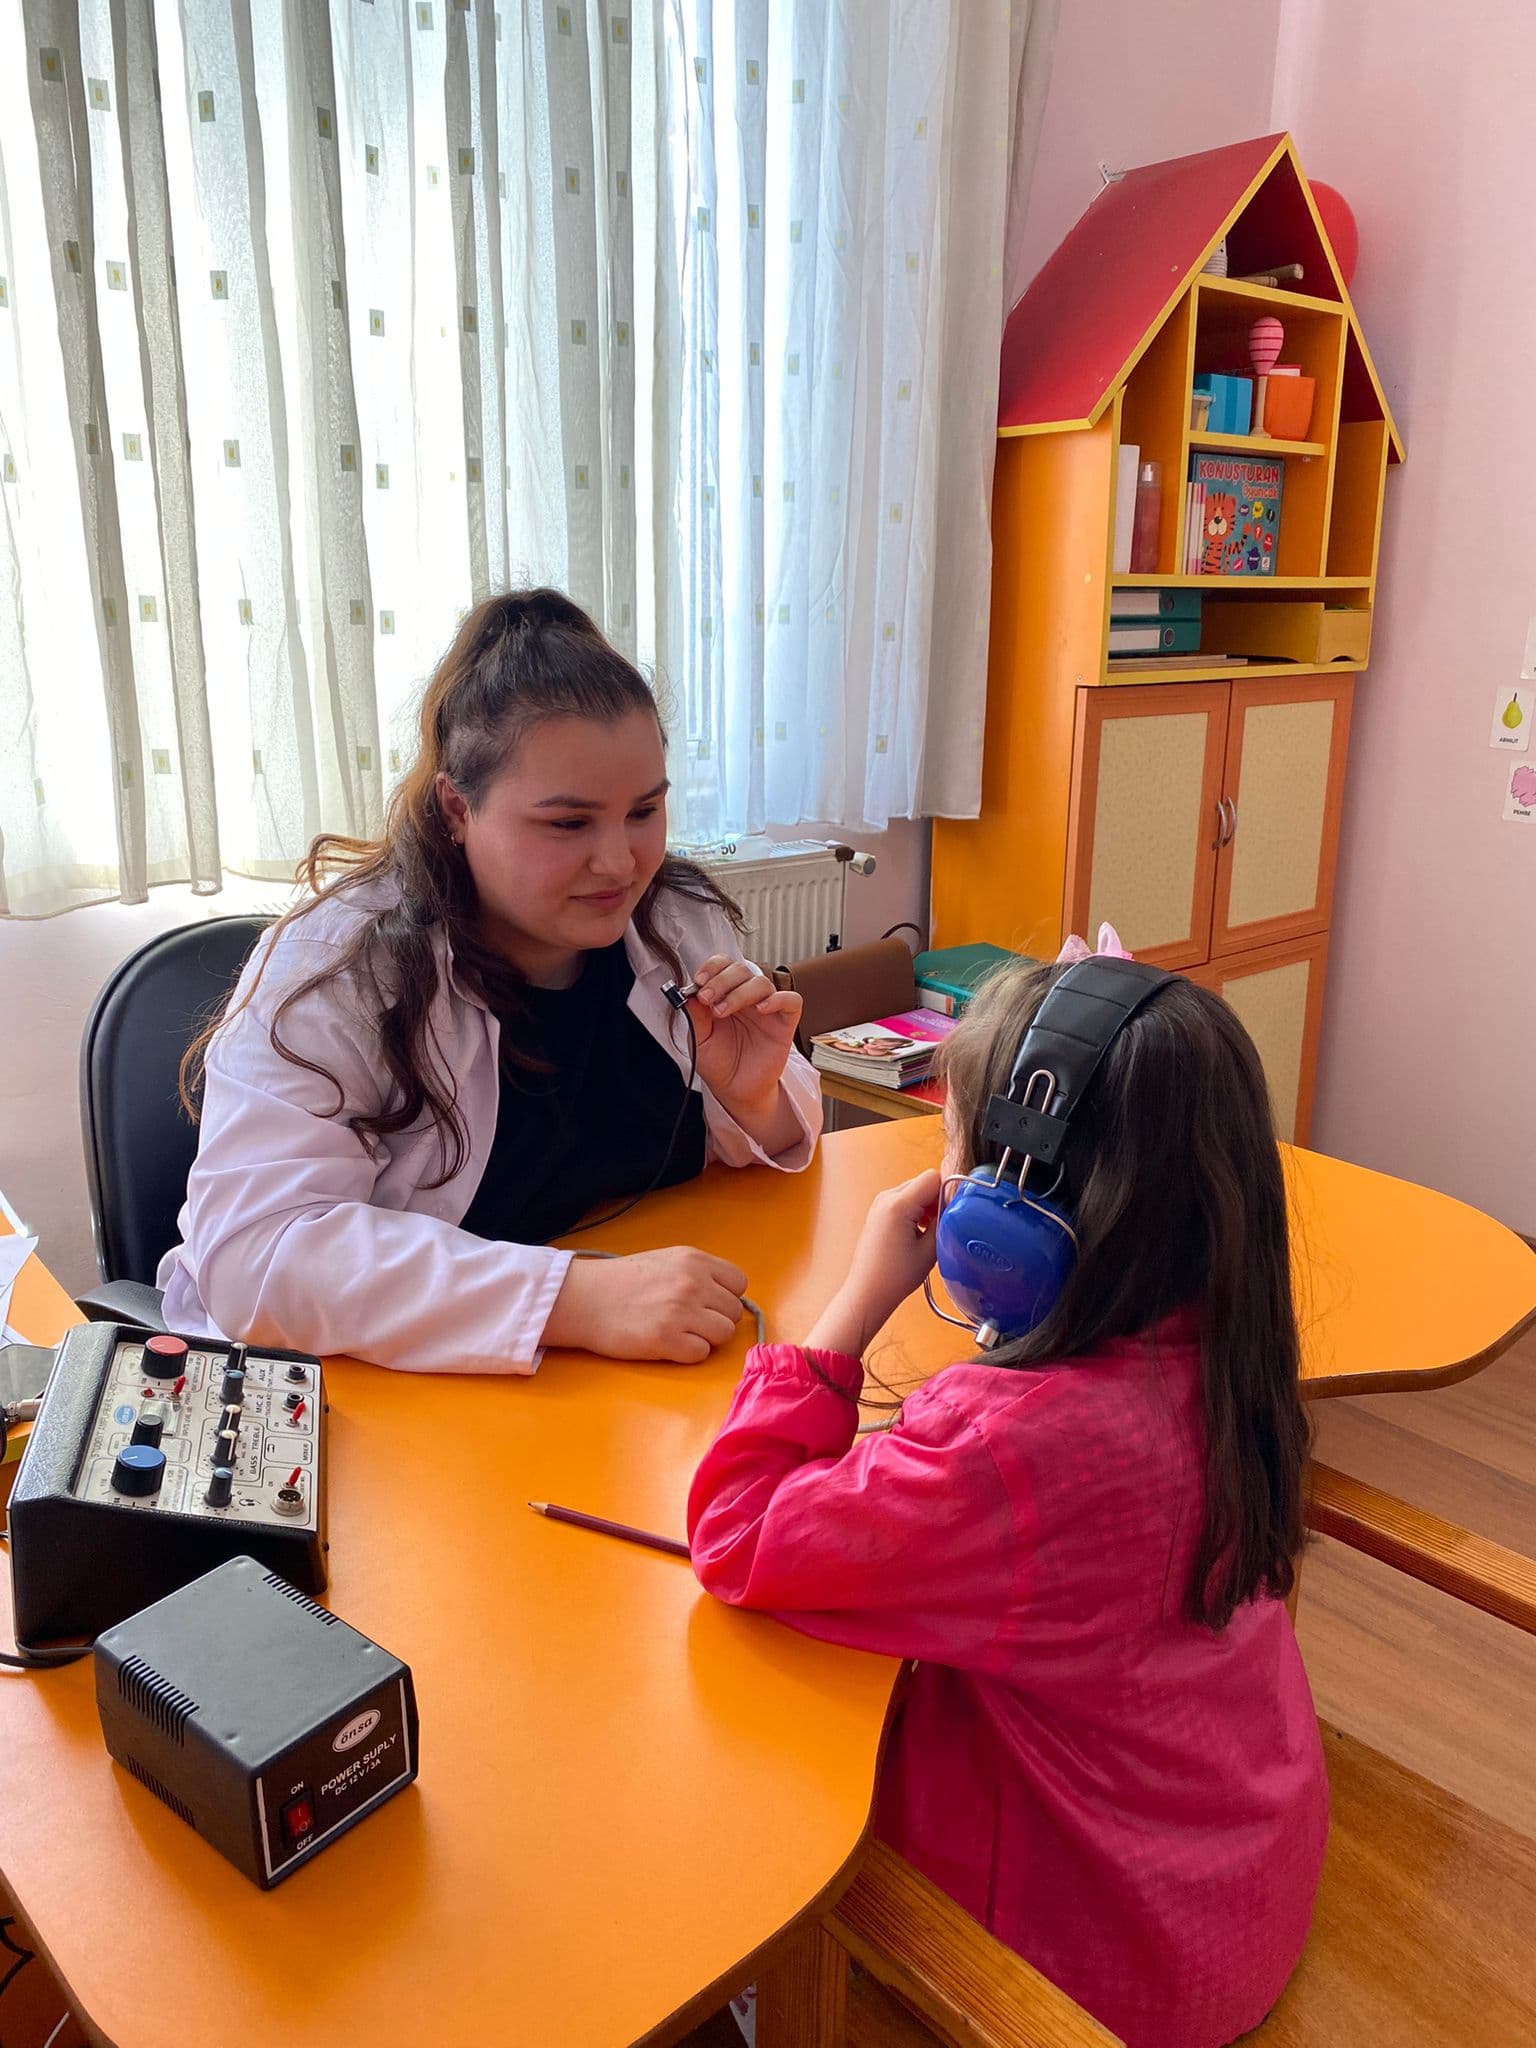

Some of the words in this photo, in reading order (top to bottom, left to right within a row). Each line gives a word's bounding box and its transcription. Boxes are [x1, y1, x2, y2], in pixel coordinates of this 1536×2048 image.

[1199, 460, 1279, 484] KONUŞTURAN
[258, 1369, 266, 1382] AUX
[252, 1426, 260, 1451] TREBLE
[249, 1455, 258, 1475] BASS
[341, 1716, 373, 1744] önsa
[321, 1759, 361, 1796] POWER
[363, 1733, 397, 1764] SUPLY
[290, 1781, 304, 1795] ON
[335, 1782, 347, 1796] DC
[296, 1833, 314, 1850] OFF
